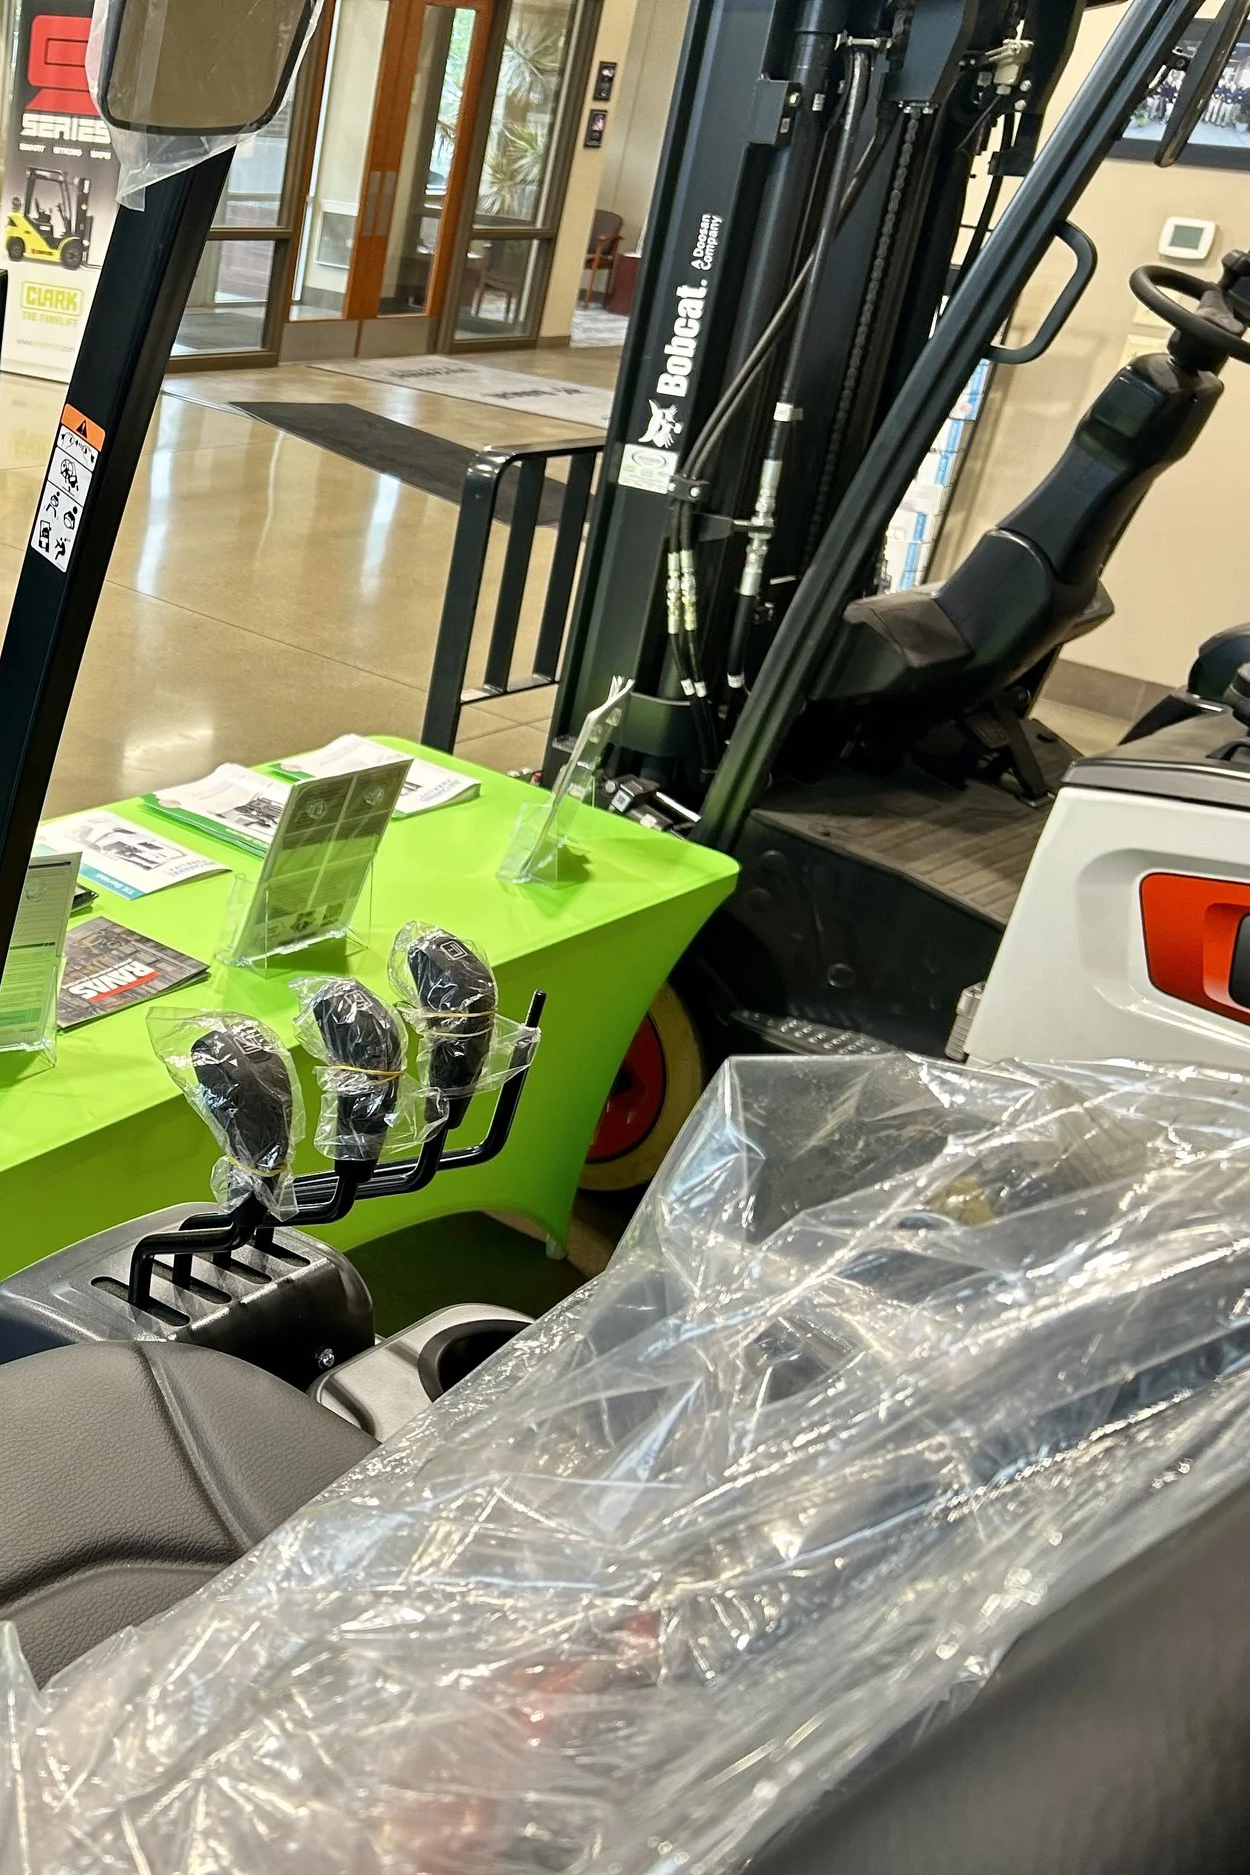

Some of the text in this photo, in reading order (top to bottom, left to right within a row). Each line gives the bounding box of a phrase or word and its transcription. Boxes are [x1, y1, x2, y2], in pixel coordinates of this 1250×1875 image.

[20, 113, 111, 144] SERIES
[690, 213, 711, 270] A Doosan
[700, 215, 723, 271] Company
[25, 285, 78, 312] CLARK
[68, 960, 155, 1000] RAVAS
